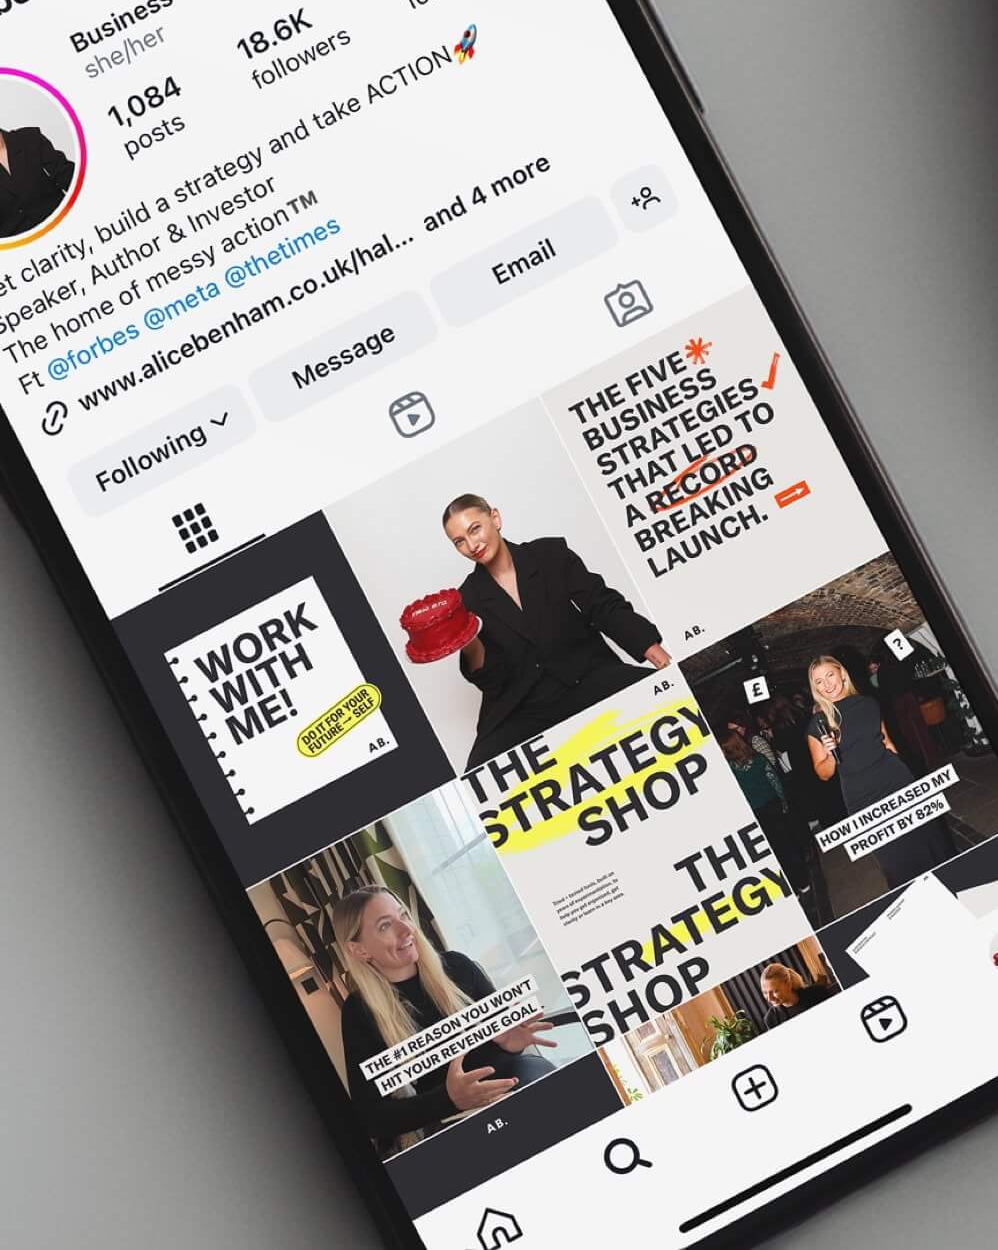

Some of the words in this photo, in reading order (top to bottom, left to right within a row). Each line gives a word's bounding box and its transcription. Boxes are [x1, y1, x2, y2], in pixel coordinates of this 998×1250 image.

[85, 27, 164, 78] she/her
[237, 8, 312, 58] 18.6K
[252, 31, 350, 89] followers
[108, 77, 180, 126] 1,084
[21, 238, 94, 282] clarity,
[95, 202, 151, 243] build
[156, 198, 170, 212] a
[175, 147, 261, 202] strategy
[269, 119, 310, 153] and
[313, 98, 360, 129] take
[368, 46, 452, 104] ACTION
[125, 117, 185, 160] posts
[424, 196, 467, 231] and
[473, 186, 487, 204] 4
[491, 158, 550, 196] more
[92, 236, 160, 285] Author
[167, 224, 187, 243] &
[188, 177, 274, 232] Investor
[492, 238, 556, 284] Email
[3, 335, 48, 363] The
[51, 301, 114, 341] home
[120, 280, 140, 305] of
[146, 246, 214, 292] messy
[19, 372, 44, 394] Ft
[48, 325, 139, 380] @forbes
[144, 283, 220, 330] @meta
[225, 220, 340, 288] @thetimes
[292, 328, 395, 389] Message
[568, 384, 625, 423] THE
[625, 351, 687, 396] FIVE
[583, 368, 716, 451] BUSINESS
[597, 379, 758, 475] STRATEGIES
[96, 426, 207, 491] Following
[607, 450, 677, 499] THAT
[682, 424, 733, 463] LED
[734, 403, 774, 432] TO
[626, 504, 647, 527] A
[646, 443, 758, 514] RECORD
[634, 468, 773, 552] BREAKING
[647, 505, 768, 578] LAUNCH.
[194, 602, 318, 683] WORK
[685, 626, 704, 640] AB.
[209, 643, 313, 713] WITH
[655, 681, 674, 695] AB.
[225, 688, 298, 745] ME!
[302, 731, 316, 745] DO
[316, 722, 325, 734] IT
[325, 709, 344, 726] FOR
[343, 689, 369, 711] YOUR
[308, 723, 344, 753] FUTURE
[353, 697, 373, 717] SELF
[370, 738, 389, 752] AB.
[461, 735, 557, 803] THE
[479, 707, 710, 848] STRATEGY
[578, 754, 707, 846] SHOP
[820, 823, 851, 846] HOW
[853, 820, 858, 829] I
[862, 782, 930, 824] INCREASED
[931, 770, 950, 787] MY
[851, 824, 895, 854] PROFIT
[897, 814, 912, 830] BY
[916, 800, 944, 819] 82%
[673, 821, 772, 892] THE
[561, 868, 792, 1009] STRATEGY
[582, 957, 709, 1047] SHOP
[365, 1055, 392, 1073] THE
[394, 1046, 407, 1060] #1
[408, 1018, 461, 1052] REASON
[461, 1003, 489, 1022] YOU
[381, 1073, 401, 1091] HIT
[403, 1054, 440, 1078] YOUR
[441, 1021, 500, 1059] REVENUE
[488, 1119, 507, 1133] AB.
